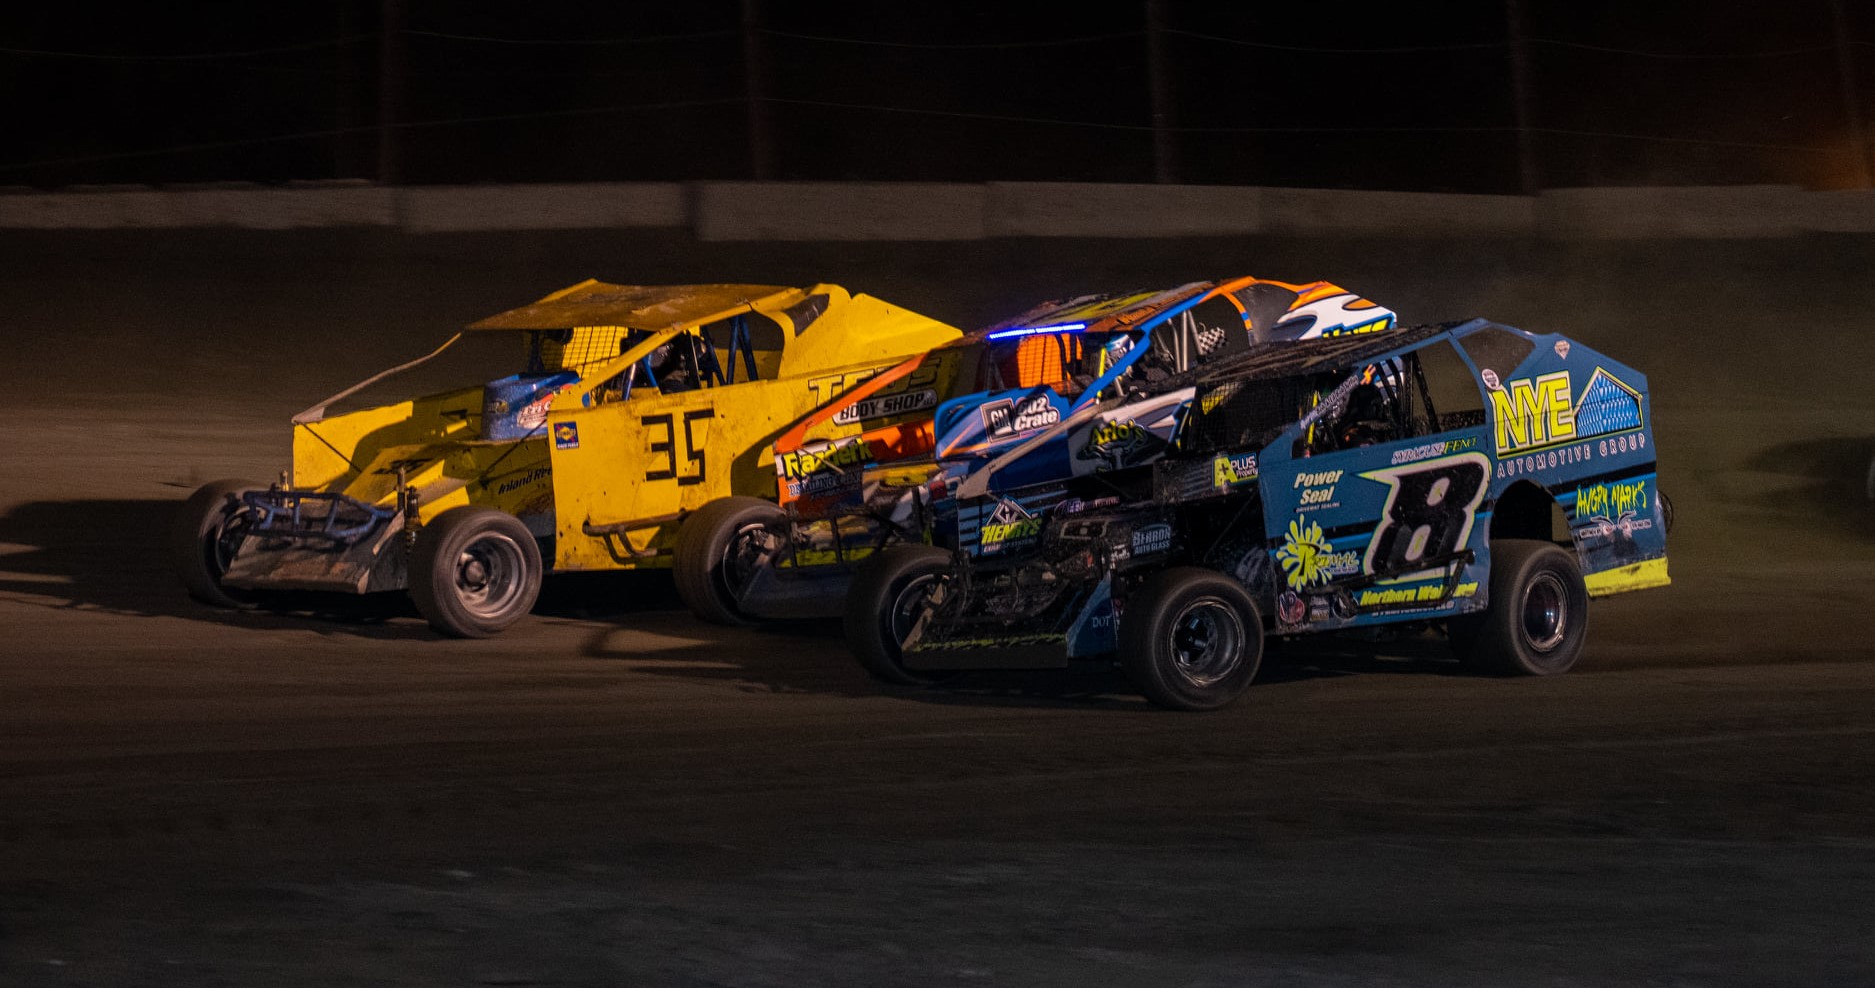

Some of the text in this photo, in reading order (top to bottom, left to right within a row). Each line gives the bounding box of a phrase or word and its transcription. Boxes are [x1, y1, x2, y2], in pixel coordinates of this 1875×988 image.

[840, 400, 881, 421] BODY
[883, 391, 924, 412] SHOP
[990, 407, 1012, 428] GM
[1490, 373, 1576, 452] NYE
[1014, 410, 1059, 432] Crate
[1092, 418, 1145, 446] Arlo's
[641, 408, 714, 486] 35
[1497, 433, 1646, 478] AUTOMOTIVE GROUP
[1230, 456, 1256, 471] PLUS
[1294, 469, 1344, 489] Power
[1300, 485, 1335, 506] Seal
[1576, 480, 1647, 519] ANGRY MARK'S
[1366, 457, 1488, 581] 8
[1151, 540, 1170, 551] GLASS
[1359, 588, 1416, 607] Northern
